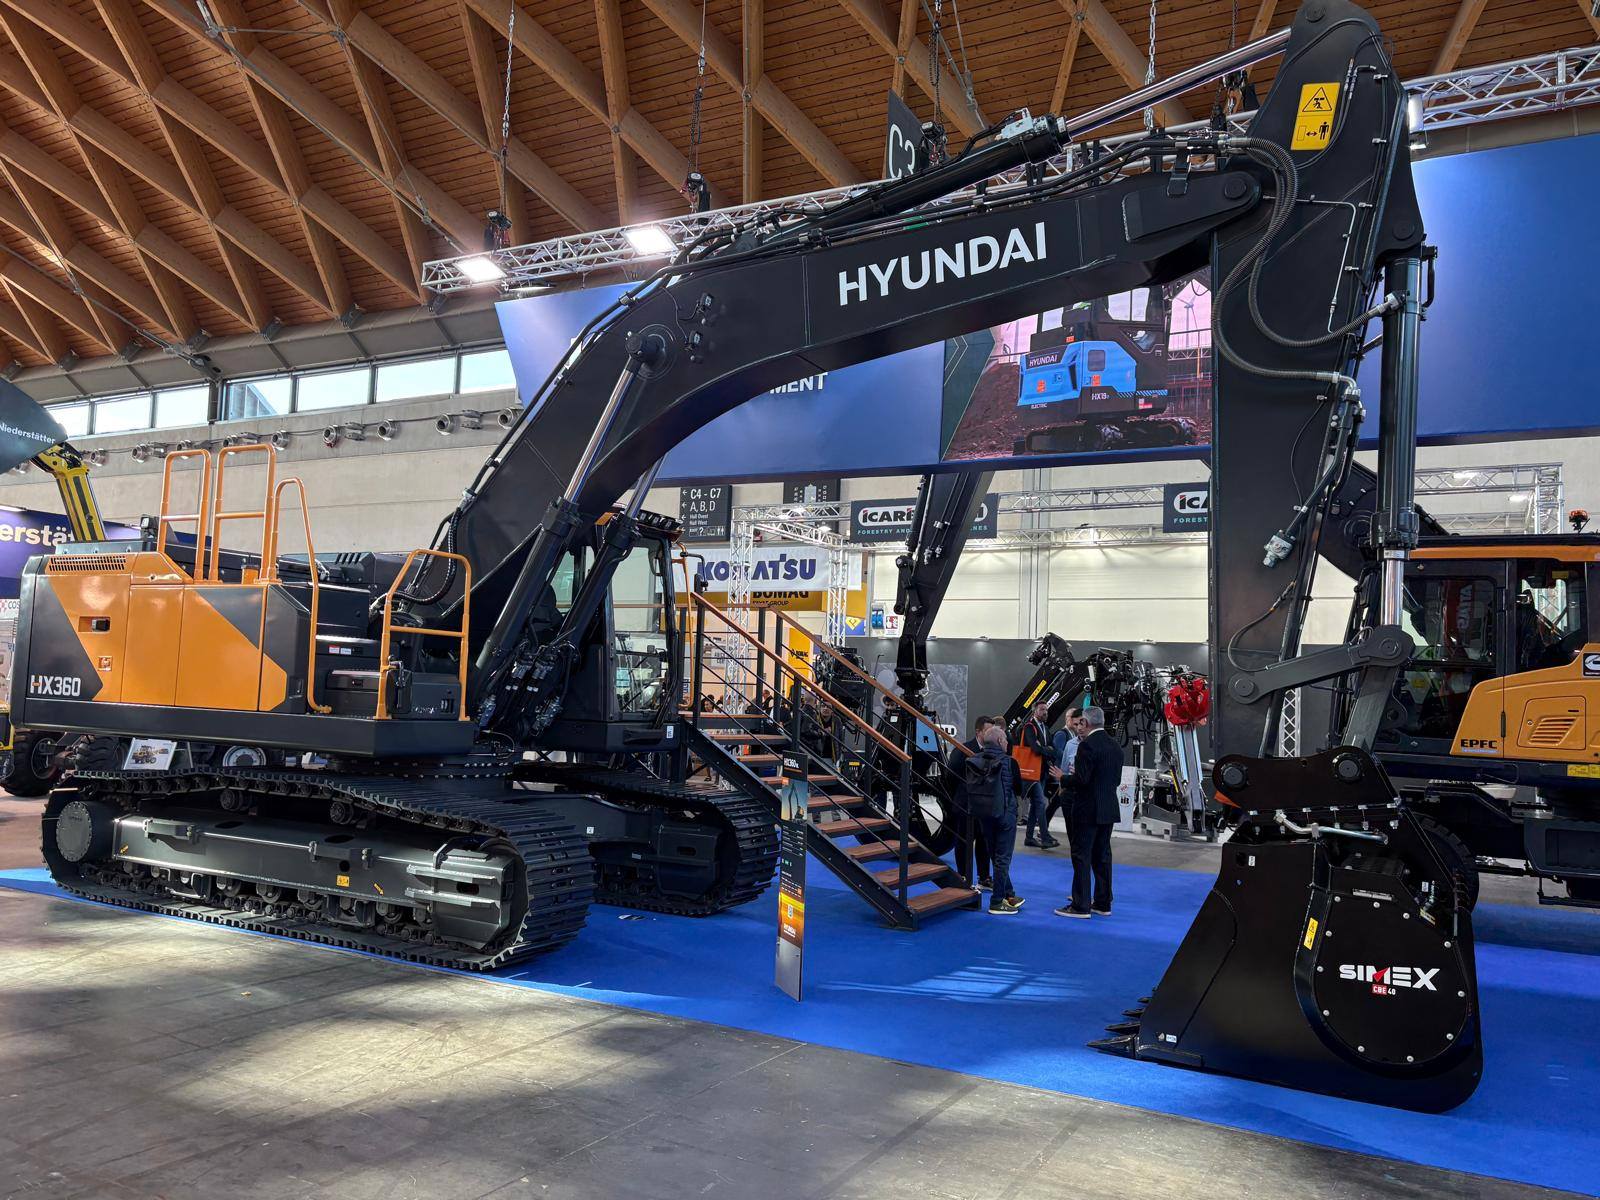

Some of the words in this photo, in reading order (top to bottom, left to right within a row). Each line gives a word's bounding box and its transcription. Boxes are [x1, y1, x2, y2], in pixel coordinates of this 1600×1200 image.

[838, 222, 1047, 306] HYUNDAI
[1029, 354, 1058, 367] HYUNDAI
[690, 488, 702, 500] C4
[709, 487, 722, 499] C7
[709, 500, 716, 511] D
[30, 674, 81, 697] HX360
[1460, 739, 1498, 749] EPFC
[1339, 964, 1441, 991] SIMEX
[1372, 985, 1387, 994] CBE
[1387, 988, 1397, 996] 40
